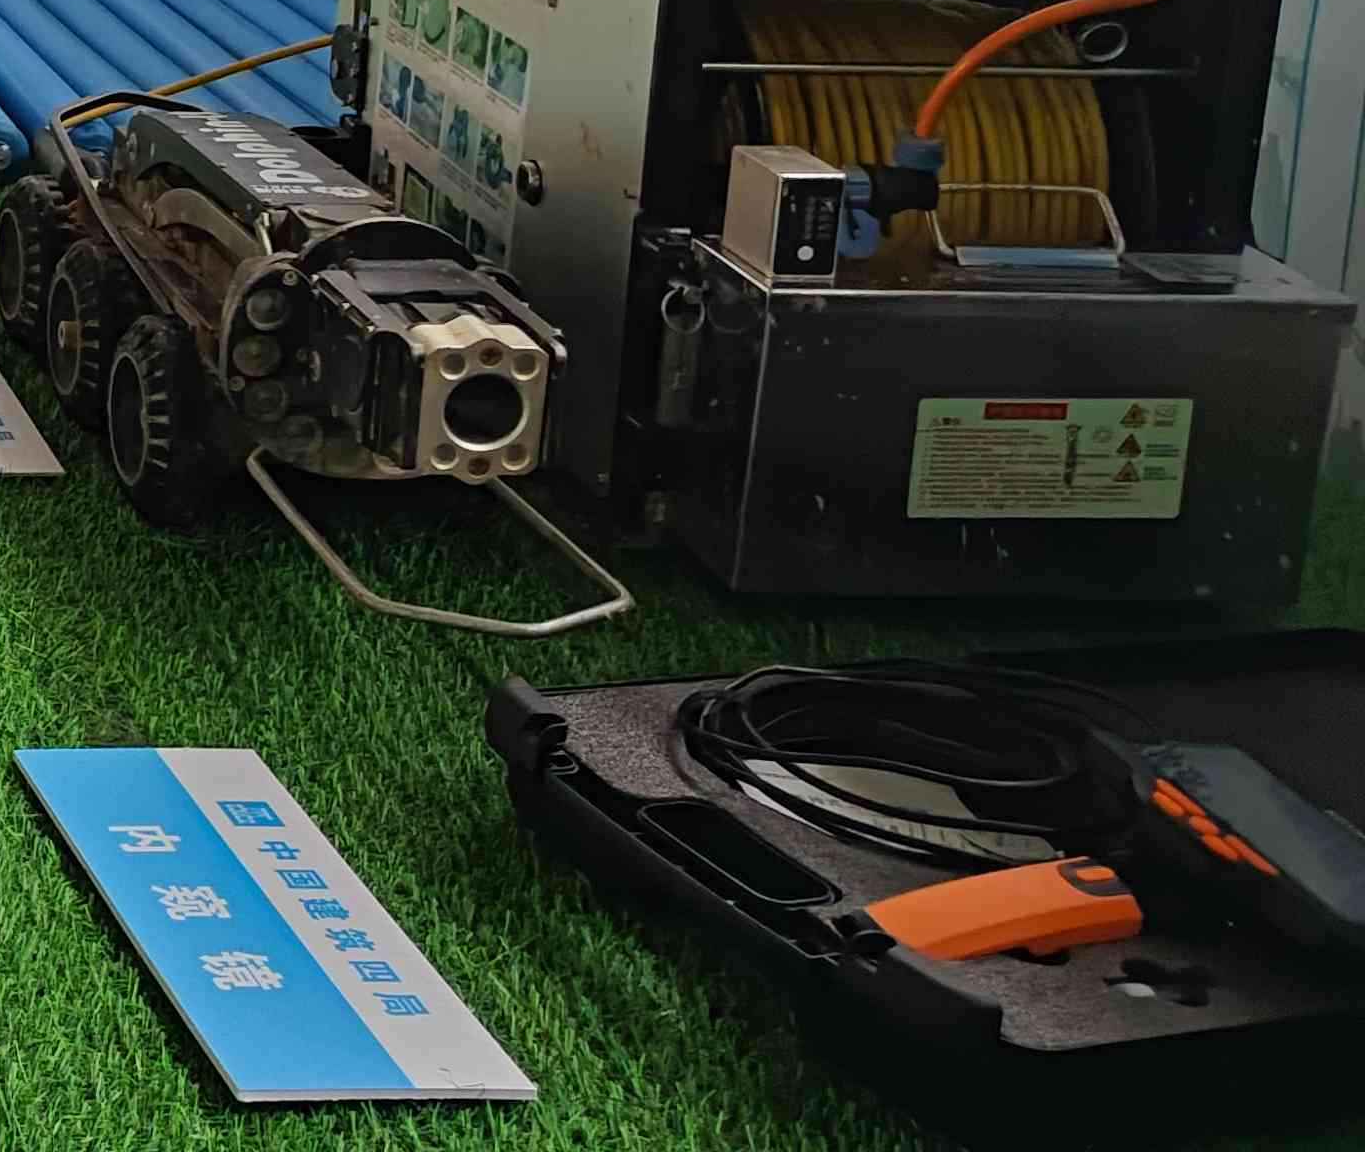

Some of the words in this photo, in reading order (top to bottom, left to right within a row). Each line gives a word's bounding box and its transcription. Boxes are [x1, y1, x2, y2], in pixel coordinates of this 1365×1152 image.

[107, 824, 285, 992] 内窥镜
[257, 840, 430, 1018] 中国建筑四局
